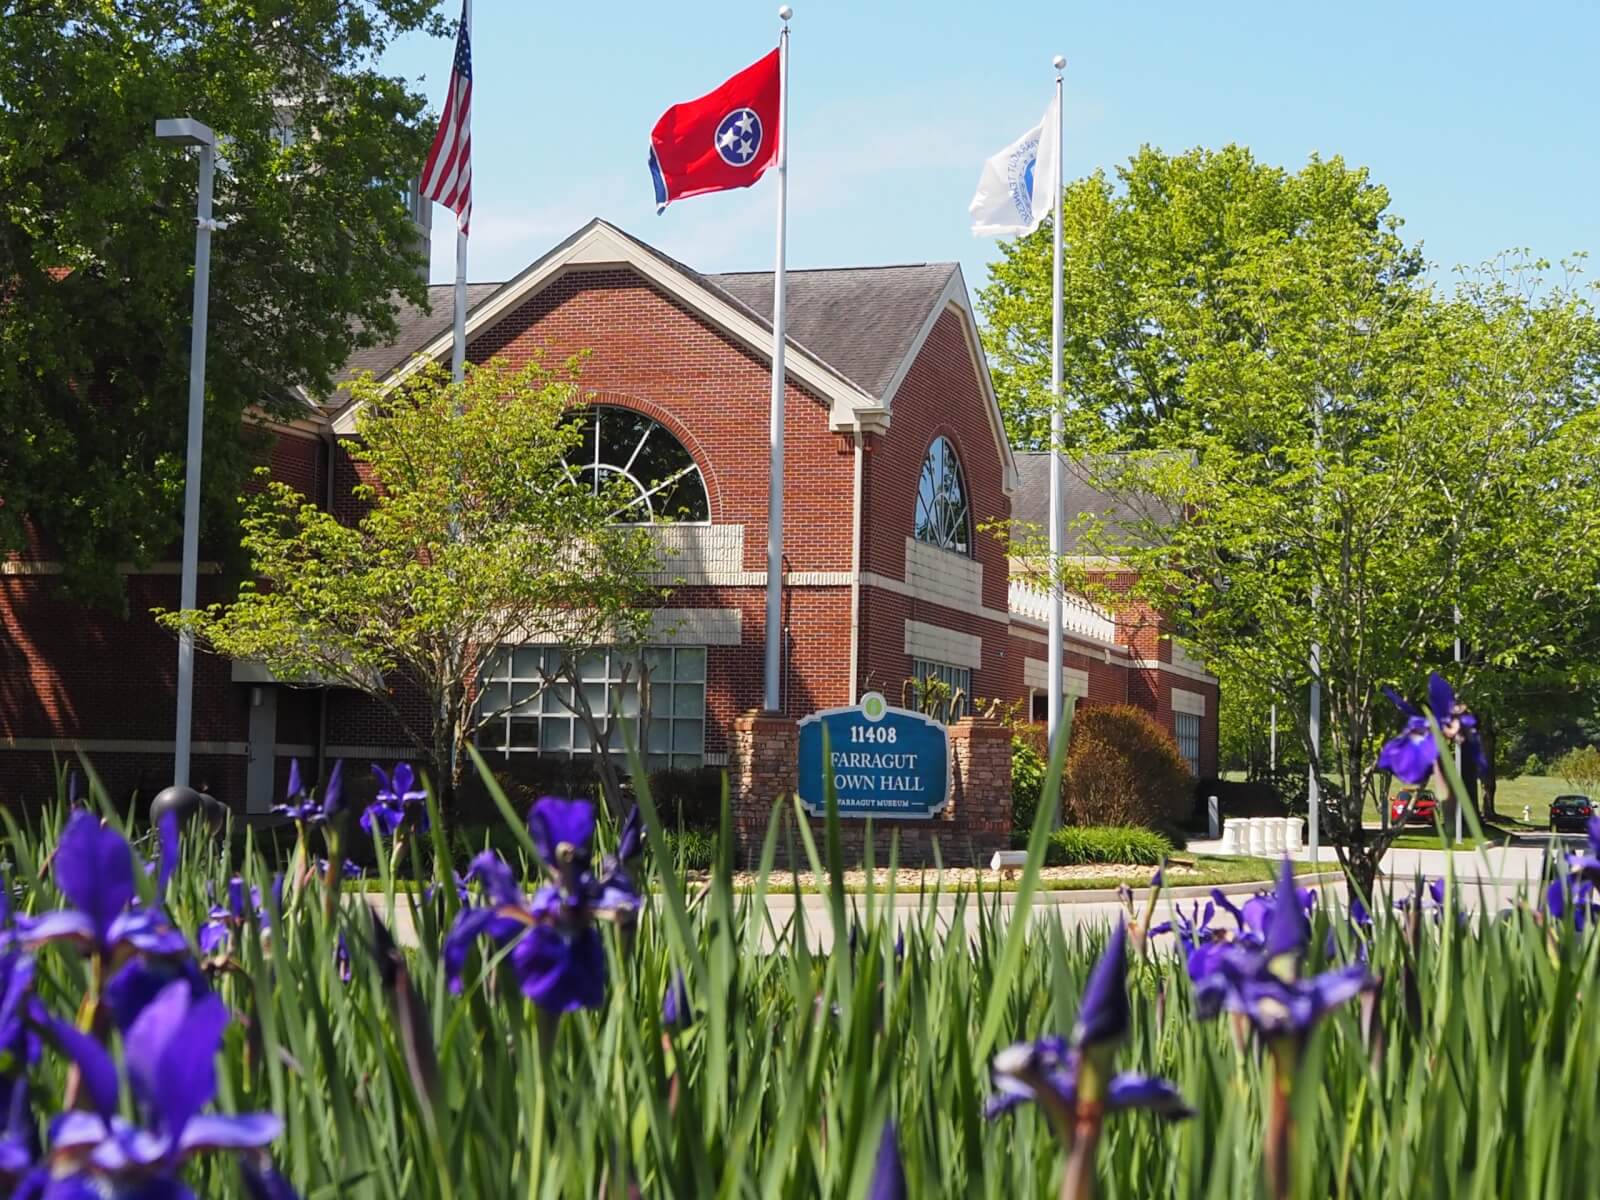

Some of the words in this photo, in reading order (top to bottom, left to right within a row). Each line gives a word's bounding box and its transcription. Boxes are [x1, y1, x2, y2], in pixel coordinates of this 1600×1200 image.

[850, 726, 897, 744] 11408
[830, 752, 918, 769] FARRAGUT
[822, 774, 875, 791] OWN
[880, 775, 925, 792] HALL
[837, 799, 876, 807] FARRAGUT
[876, 800, 909, 808] MUSEUM
